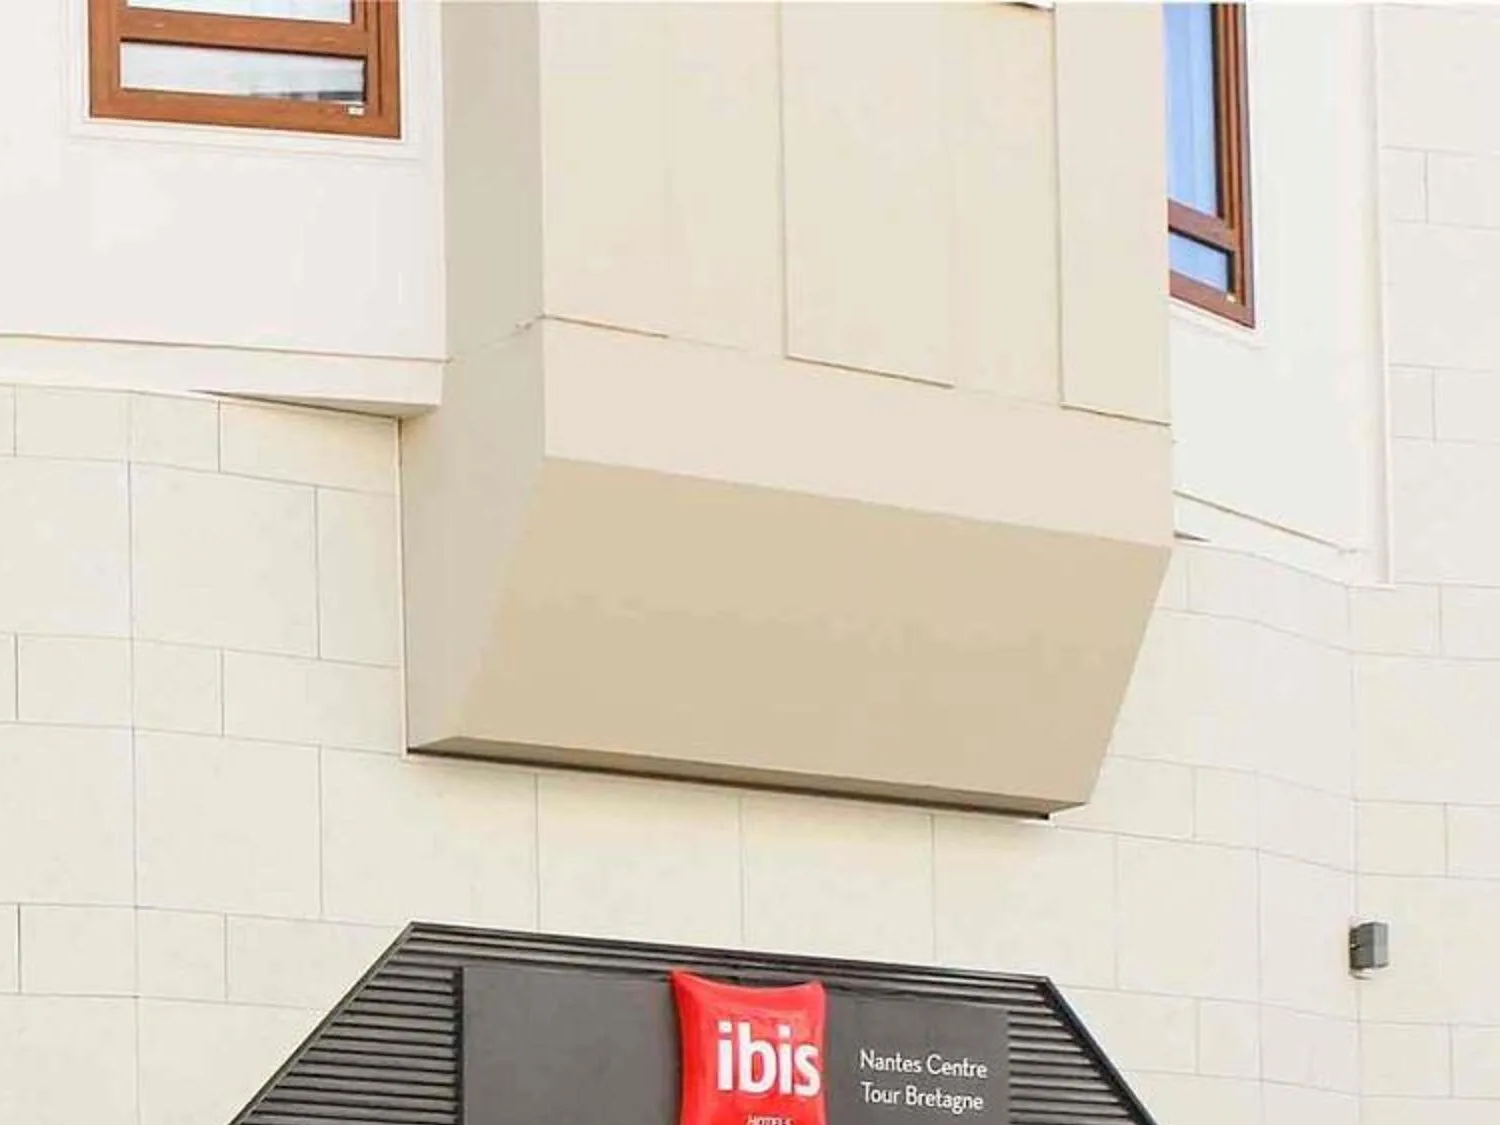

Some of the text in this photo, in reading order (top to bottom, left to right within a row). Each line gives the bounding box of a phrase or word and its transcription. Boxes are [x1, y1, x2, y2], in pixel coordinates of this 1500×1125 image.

[716, 1020, 822, 1098] ibis
[860, 1049, 989, 1079] Nantes Centre
[861, 1080, 985, 1115] Tour Bretagne
